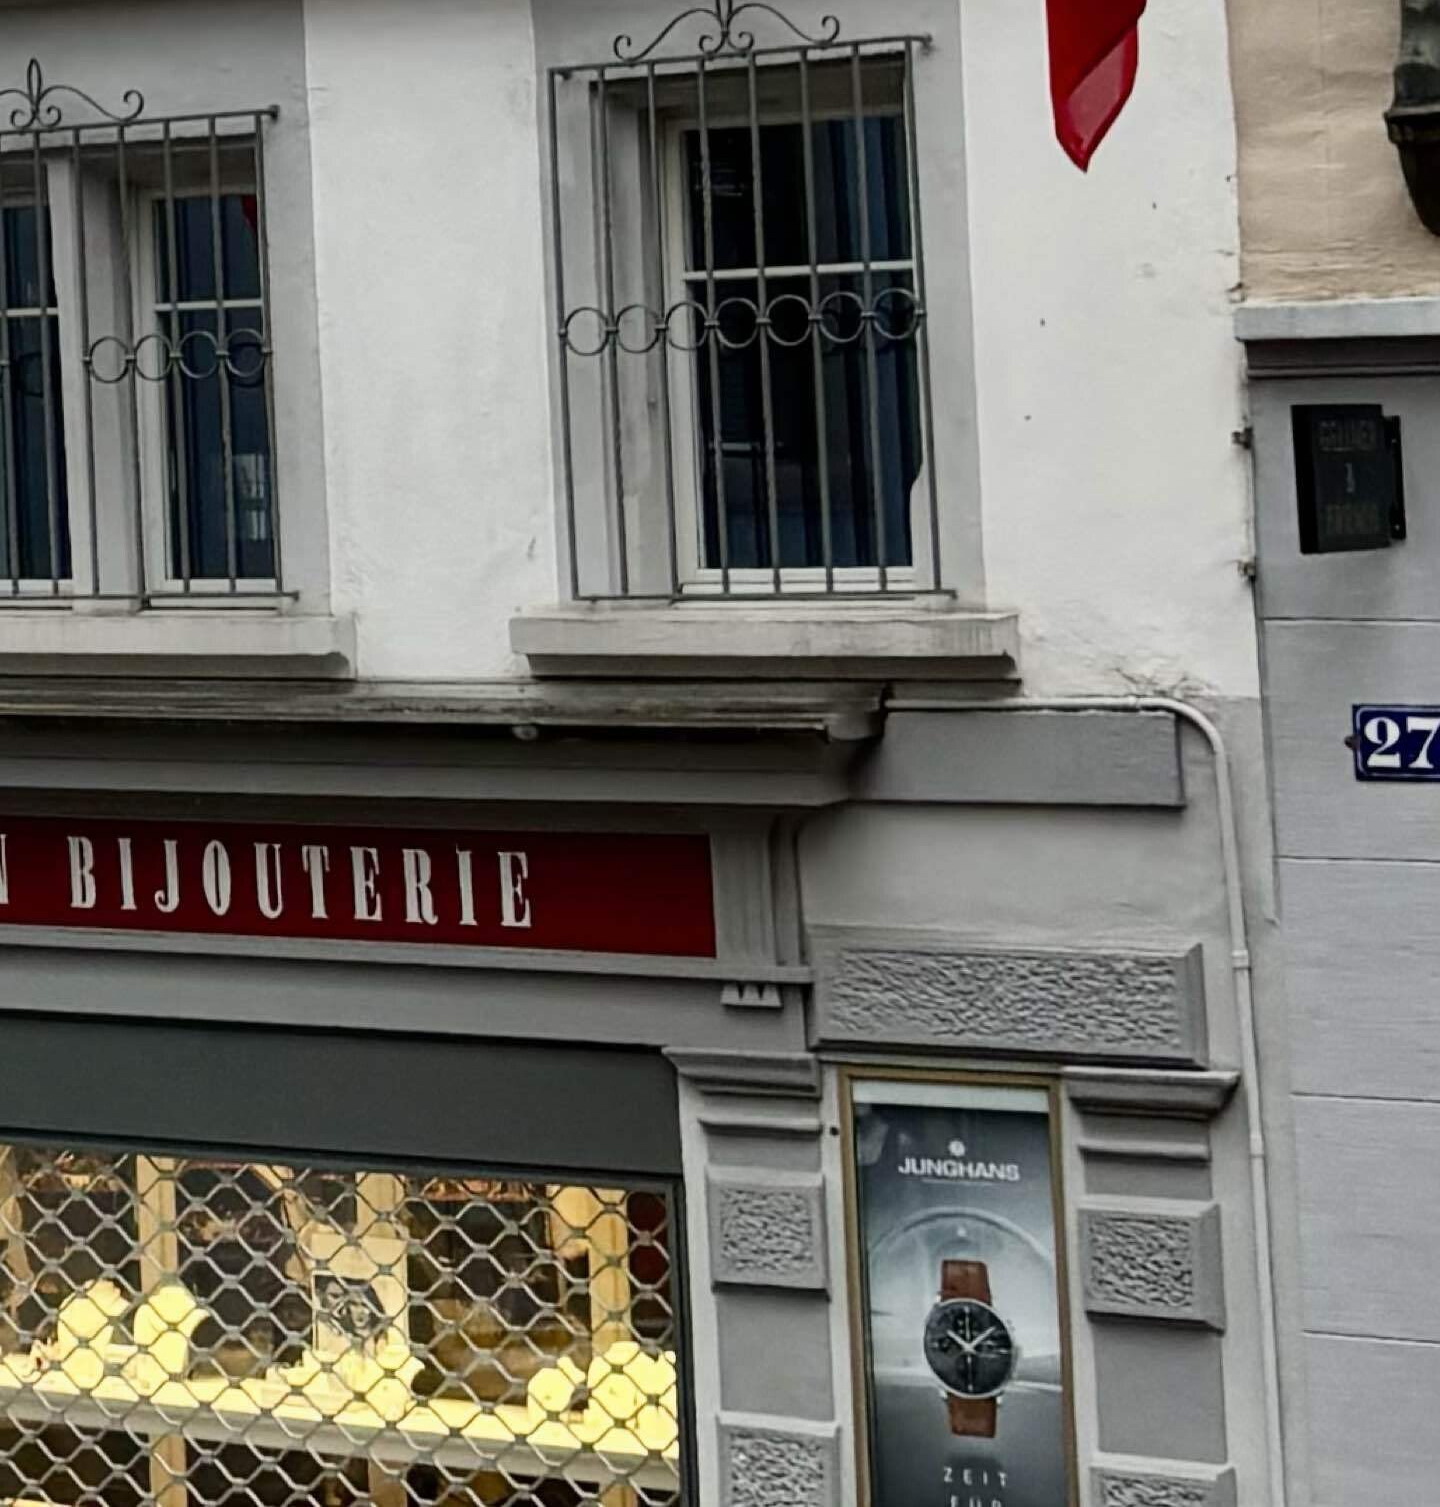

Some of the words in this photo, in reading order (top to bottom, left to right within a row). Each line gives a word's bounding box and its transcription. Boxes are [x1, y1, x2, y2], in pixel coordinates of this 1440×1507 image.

[1364, 716, 1440, 769] 27
[67, 835, 532, 929] BIJOUTERIE
[897, 1157, 1021, 1182] JUNGHANS
[943, 1466, 1007, 1487] ZEIT
